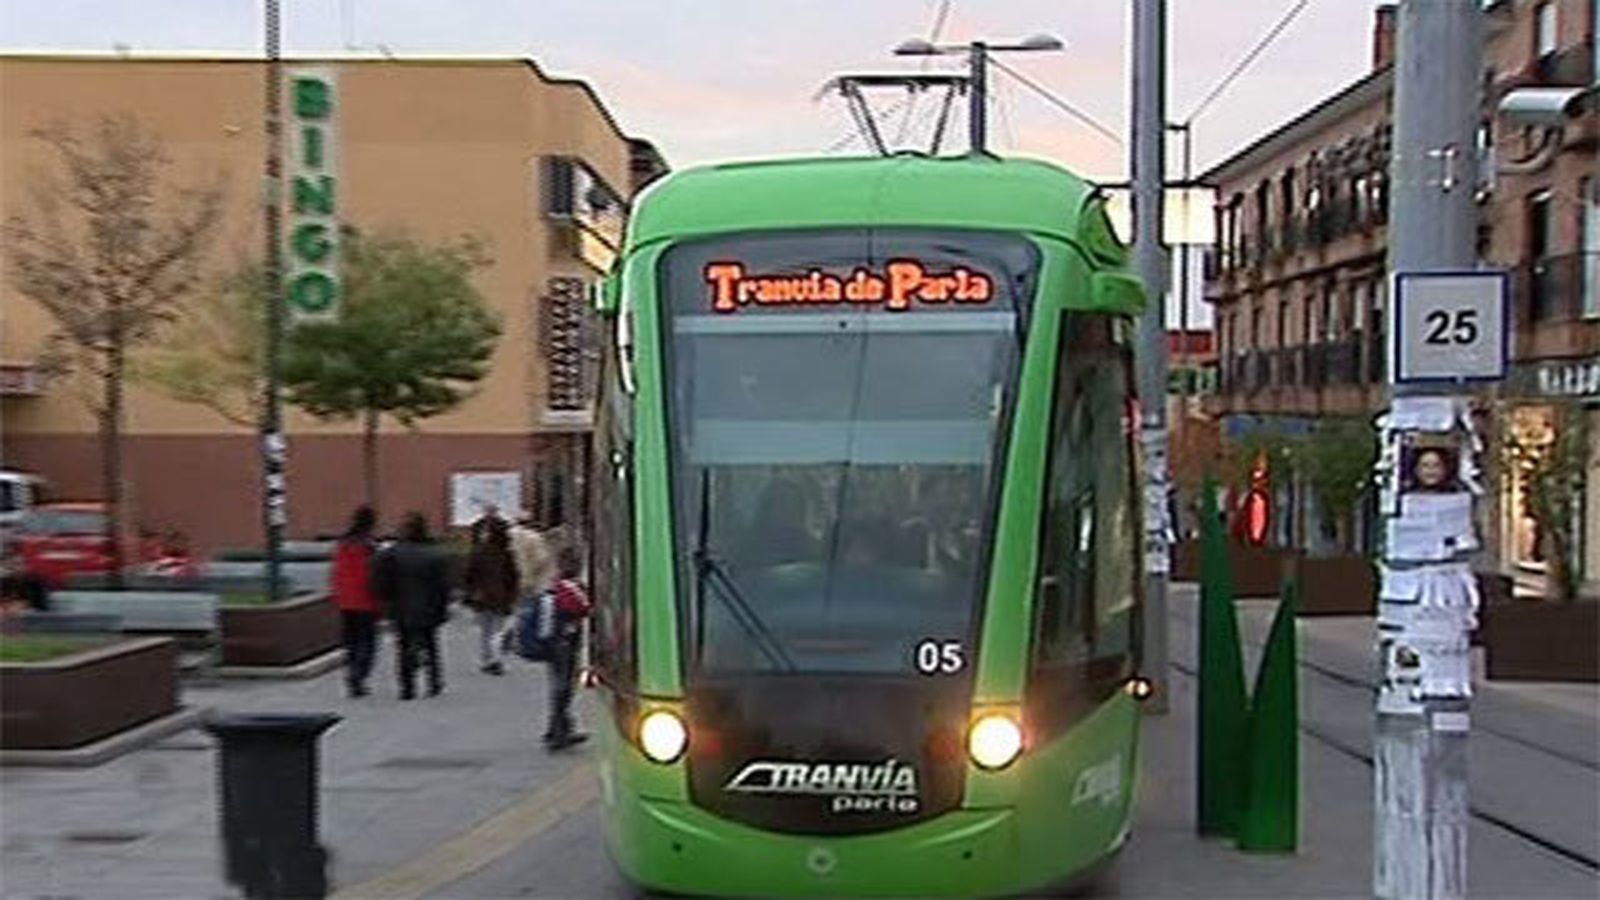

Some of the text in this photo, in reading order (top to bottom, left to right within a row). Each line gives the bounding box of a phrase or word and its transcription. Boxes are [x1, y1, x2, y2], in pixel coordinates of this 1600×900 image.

[290, 79, 336, 313] BINGO
[845, 270, 886, 302] de
[887, 260, 991, 309] Parla
[1424, 310, 1478, 345] 25
[917, 641, 964, 673] 05
